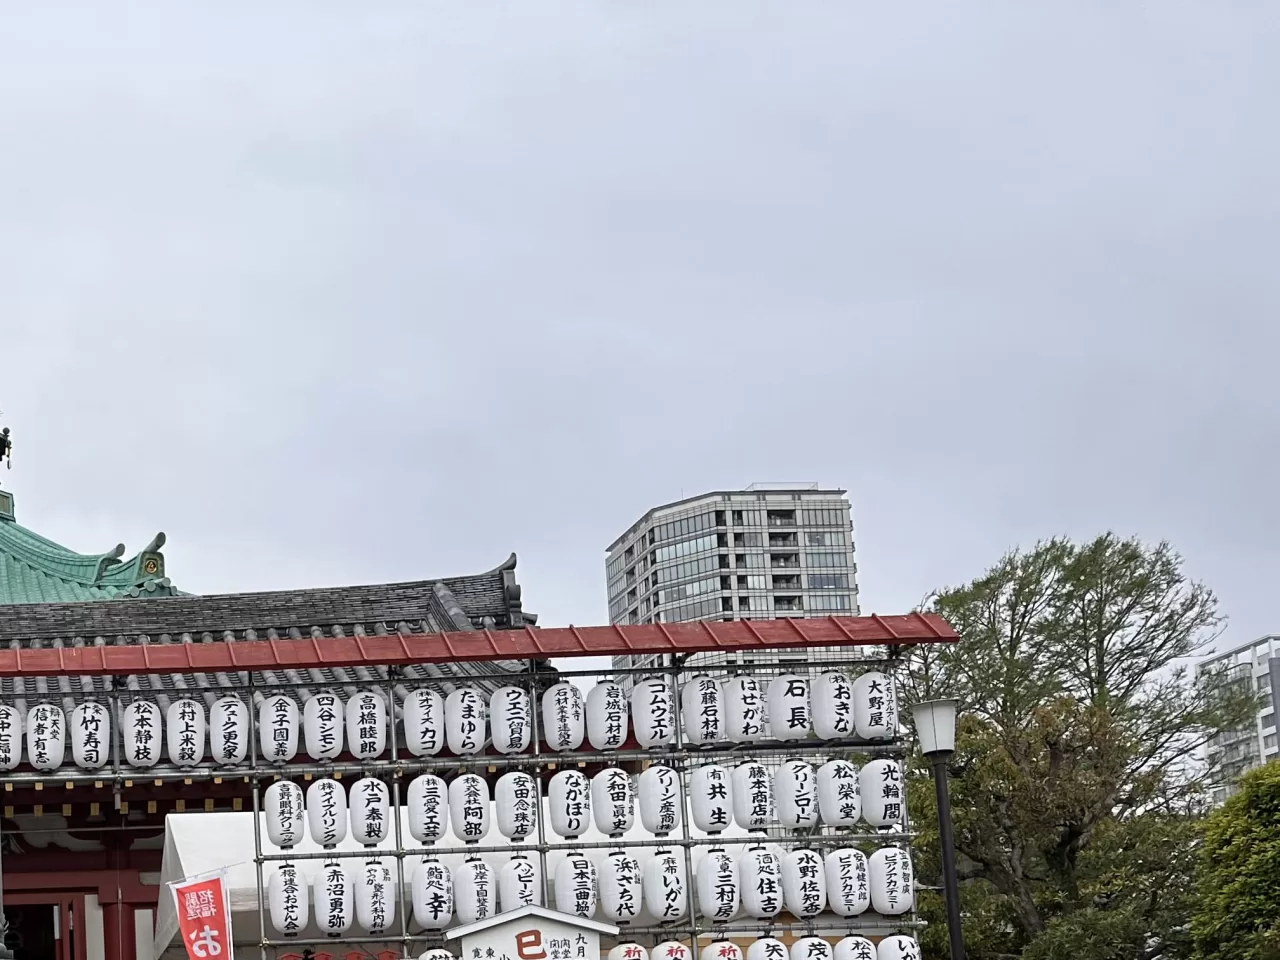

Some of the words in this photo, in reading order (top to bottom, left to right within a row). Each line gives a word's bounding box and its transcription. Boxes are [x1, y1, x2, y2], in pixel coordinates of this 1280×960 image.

[132, 702, 154, 760] 松本静枝
[219, 699, 239, 759] デューク更家
[270, 697, 291, 756] 金子國義
[316, 697, 336, 753] 四谷シモン
[459, 688, 478, 749] たまゆら
[506, 687, 526, 750] ウエニ貿易
[603, 684, 623, 747] 岩城石材店
[648, 683, 669, 740] コムウエル
[699, 679, 719, 740] 須藤石材(株)
[741, 679, 759, 735] はせがわ
[784, 679, 808, 729] 石長
[829, 675, 851, 732] (株)おきな
[868, 680, 885, 727] 大野屋
[32, 706, 50, 763] 信者有志
[80, 714, 101, 763] 竹寿司
[421, 777, 442, 838] (株)三愛工芸
[512, 774, 531, 836] 安田念珠店
[564, 772, 583, 832] なかほり
[655, 767, 677, 831] クリーン産商(株)
[707, 768, 728, 826] (有)共生
[748, 765, 768, 827] 藤本商店(株)
[792, 763, 812, 824] クリーンロード
[832, 762, 857, 819] 松榮堂
[880, 762, 902, 821] 光輪閣
[326, 869, 345, 928] 赤沼勇弥
[425, 866, 448, 920] 鮨処幸
[613, 858, 635, 918] 浜さち代
[662, 857, 683, 918] 麻布いがた
[755, 854, 778, 914] 酒処住吉
[797, 851, 822, 915] 水野佐知香
[839, 854, 855, 911] ピアノアカデミー
[885, 853, 899, 909] ピアノアカデミー
